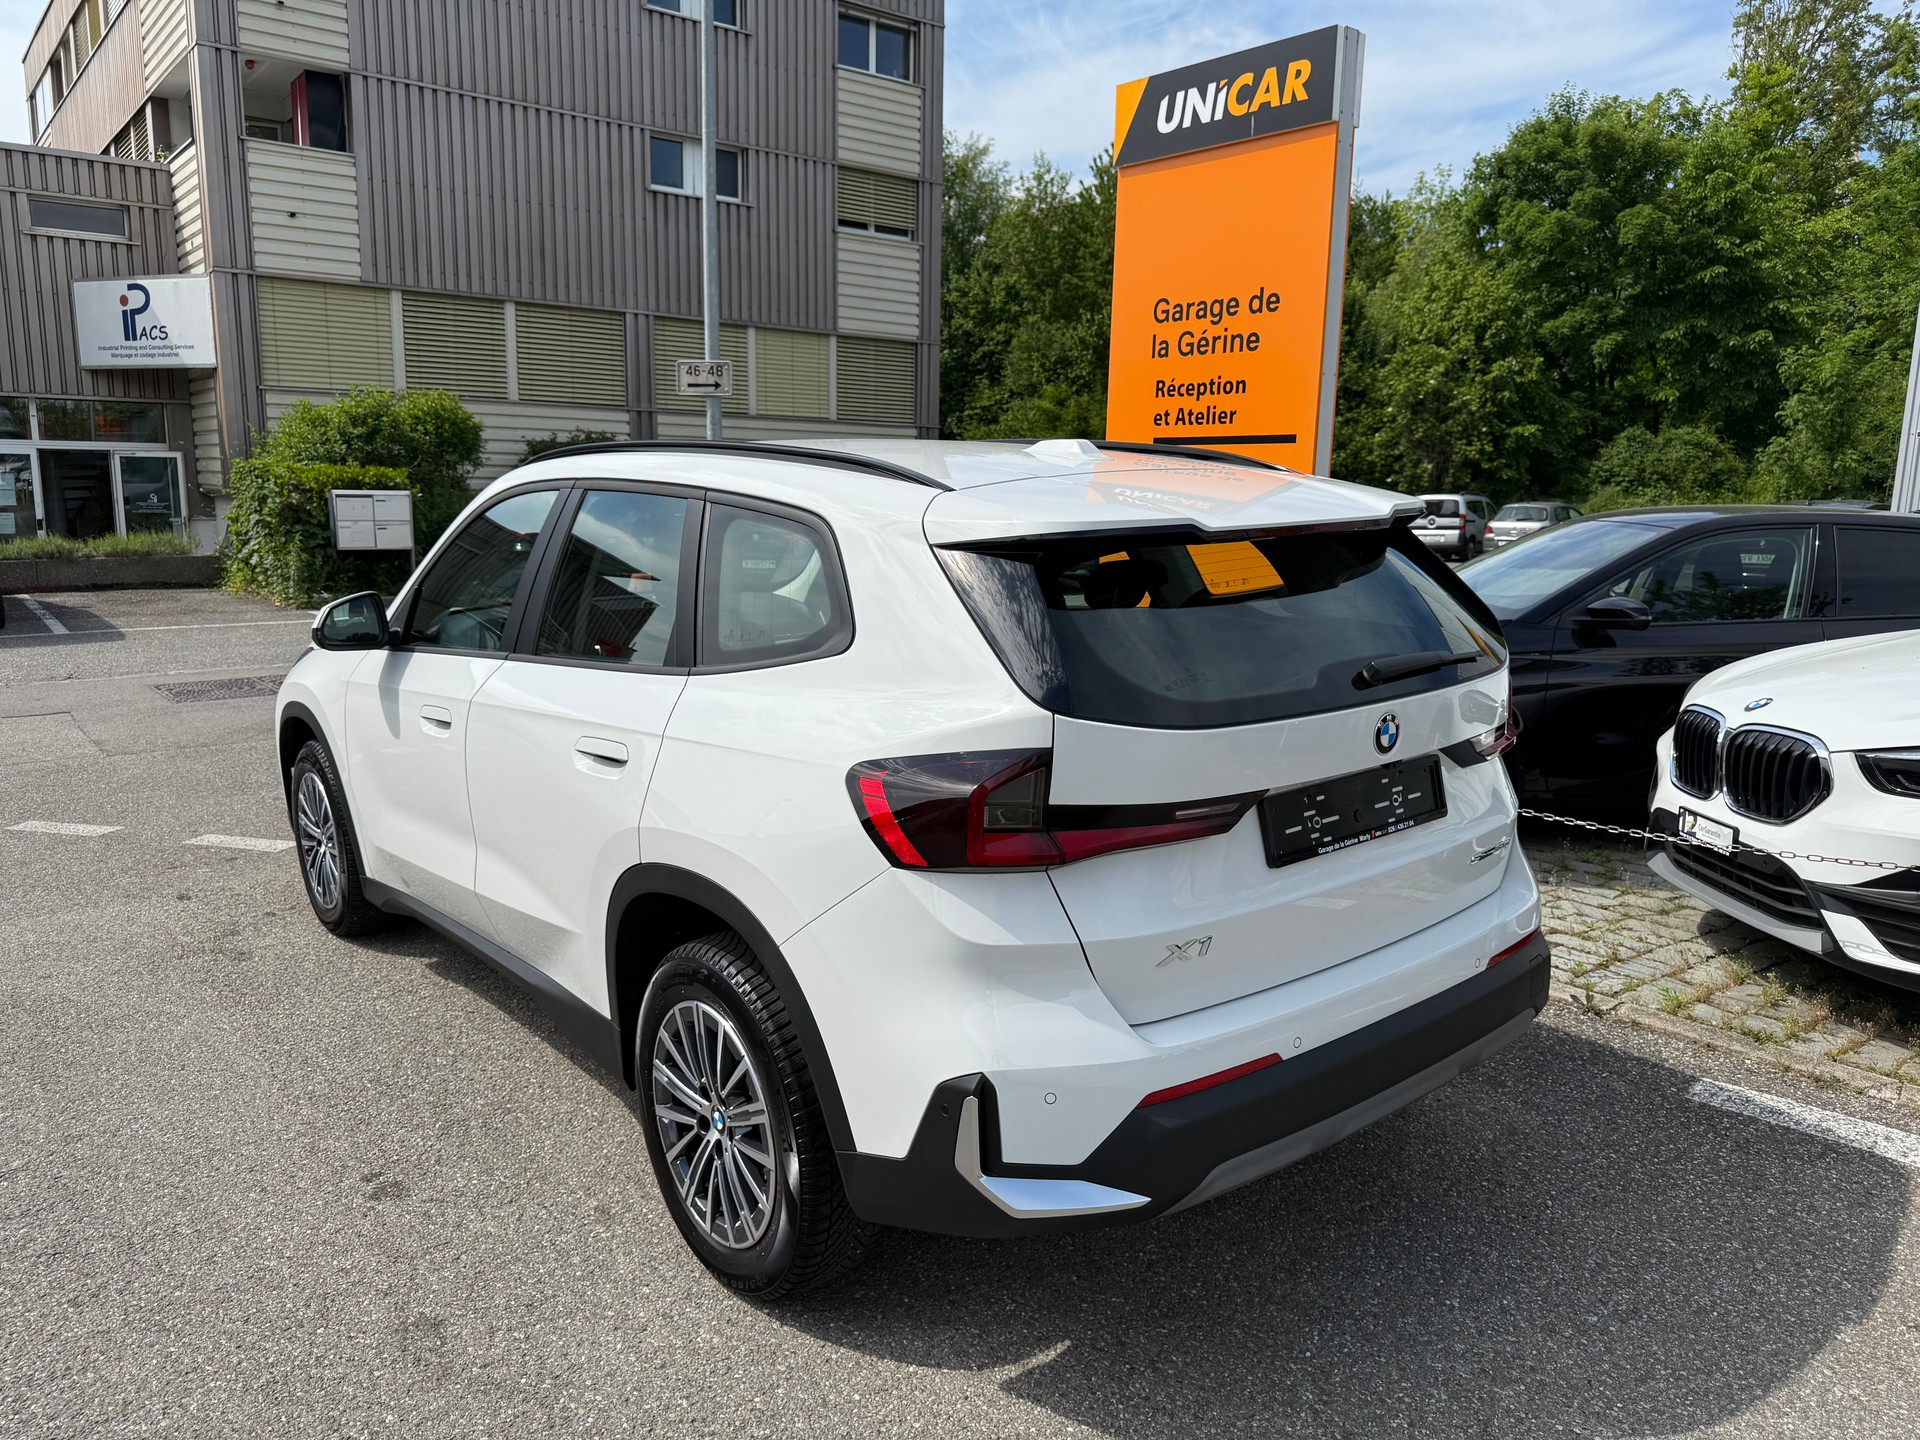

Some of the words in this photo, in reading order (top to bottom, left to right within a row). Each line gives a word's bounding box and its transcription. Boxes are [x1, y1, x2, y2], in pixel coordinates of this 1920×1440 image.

[1153, 297, 1240, 325] Garage
[1248, 286, 1281, 315] de
[120, 344, 139, 352] Printing
[148, 344, 174, 352] Consulting
[1151, 334, 1170, 359] la
[1177, 327, 1260, 357] Gérine
[1155, 375, 1247, 401] Réception
[1153, 409, 1171, 427] et
[1174, 405, 1237, 426] Atelier
[1318, 845, 1334, 854] Garage
[1334, 842, 1340, 850] de
[1344, 837, 1359, 846] Gérine
[1156, 935, 1213, 967] X1
